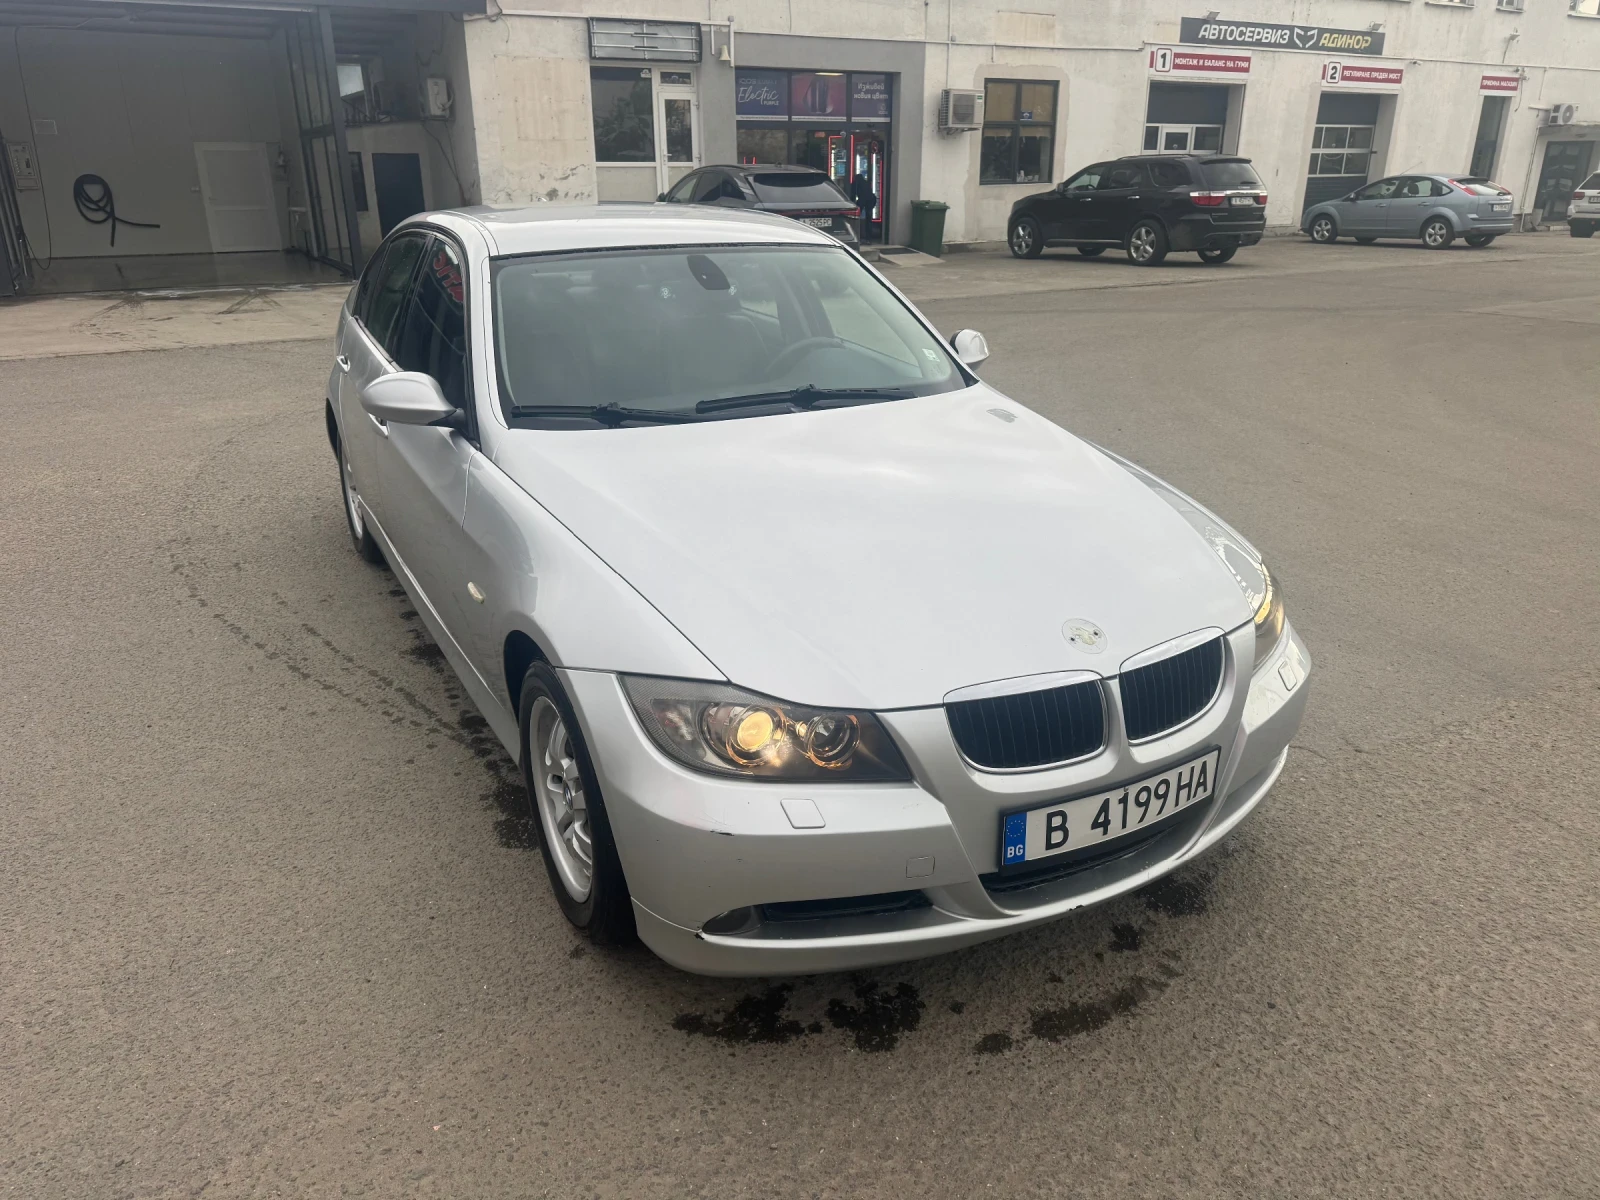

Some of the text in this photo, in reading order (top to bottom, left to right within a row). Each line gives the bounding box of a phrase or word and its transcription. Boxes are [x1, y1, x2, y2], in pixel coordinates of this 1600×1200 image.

[1198, 24, 1371, 49] АВТОСЕРВИЗ АДИНОР
[1160, 52, 1167, 68] 1
[1174, 58, 1198, 66] МОНТАЖ
[1198, 58, 1203, 66] И
[1204, 59, 1226, 67] БАЛАНС
[1330, 66, 1338, 80] 2
[857, 82, 885, 91] Изживей
[738, 86, 779, 105] Electric
[853, 91, 871, 99] новия
[1045, 809, 1069, 851] B
[1006, 843, 1024, 858] BG
